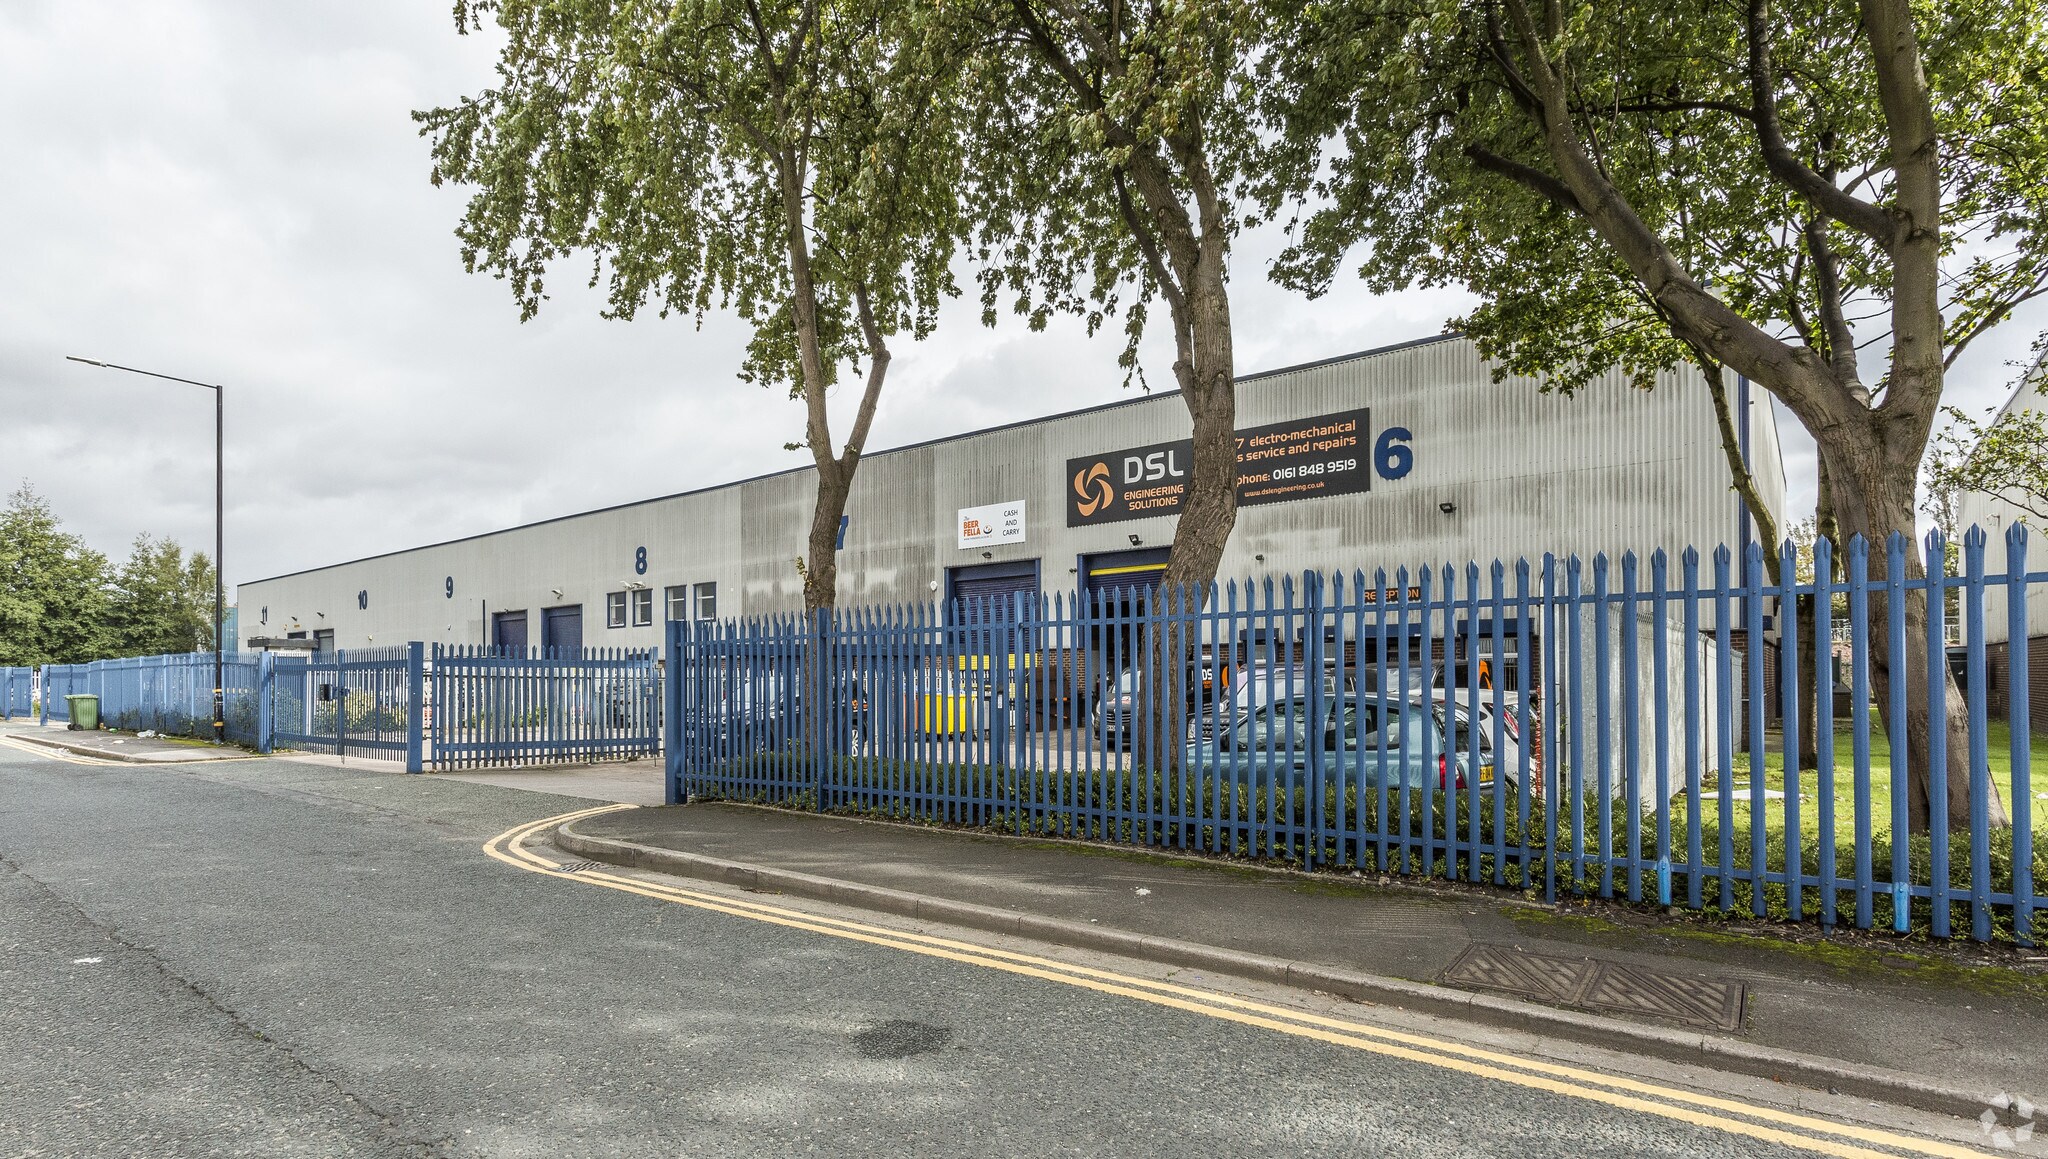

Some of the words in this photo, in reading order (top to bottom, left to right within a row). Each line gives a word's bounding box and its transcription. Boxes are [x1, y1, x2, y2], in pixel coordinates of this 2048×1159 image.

[1249, 420, 1356, 447] electro-mechanical
[1246, 448, 1285, 461] service
[1288, 444, 1310, 455] and
[1313, 435, 1357, 452] repairs
[1374, 427, 1413, 481] 6
[1124, 450, 1184, 484] DSL
[1236, 474, 1271, 487] phone:
[1273, 466, 1296, 480] 0161
[1299, 462, 1324, 477] 848
[1327, 458, 1357, 473] 9519
[1124, 484, 1184, 501] ENGINEERING
[1128, 496, 1179, 511] SOLUTIONS
[1003, 509, 1019, 518] CASH
[1005, 519, 1018, 527] AND
[963, 520, 979, 529] BEER
[963, 528, 981, 537] FELLA
[1002, 528, 1020, 537] CARRY
[635, 546, 648, 575] 8
[445, 576, 454, 599] 9
[357, 589, 368, 610] 10
[261, 605, 268, 622] 11
